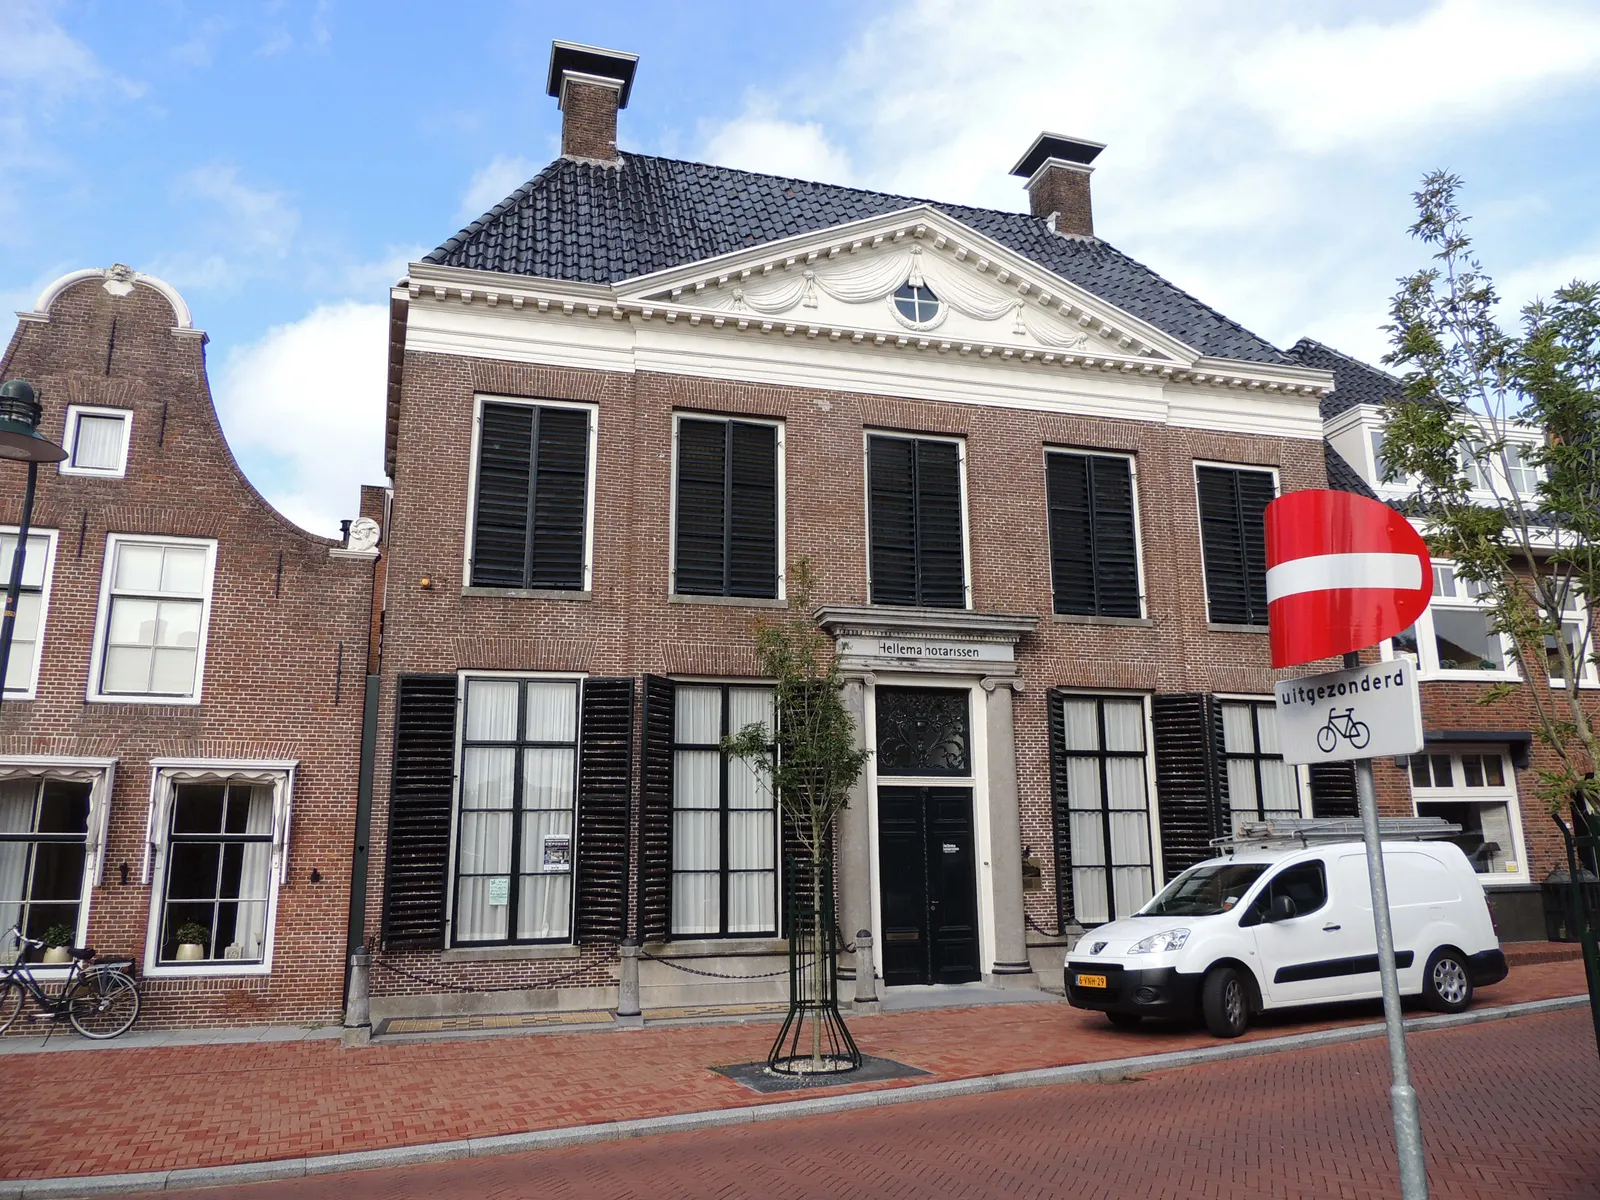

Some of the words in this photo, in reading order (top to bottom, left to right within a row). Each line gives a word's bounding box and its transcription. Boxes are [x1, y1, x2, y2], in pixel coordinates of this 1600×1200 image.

[879, 642, 922, 655] Hellema
[925, 643, 979, 657] notarissen
[1281, 669, 1404, 706] uitgezonderd
[1078, 975, 1105, 987] 6-VNH-29
